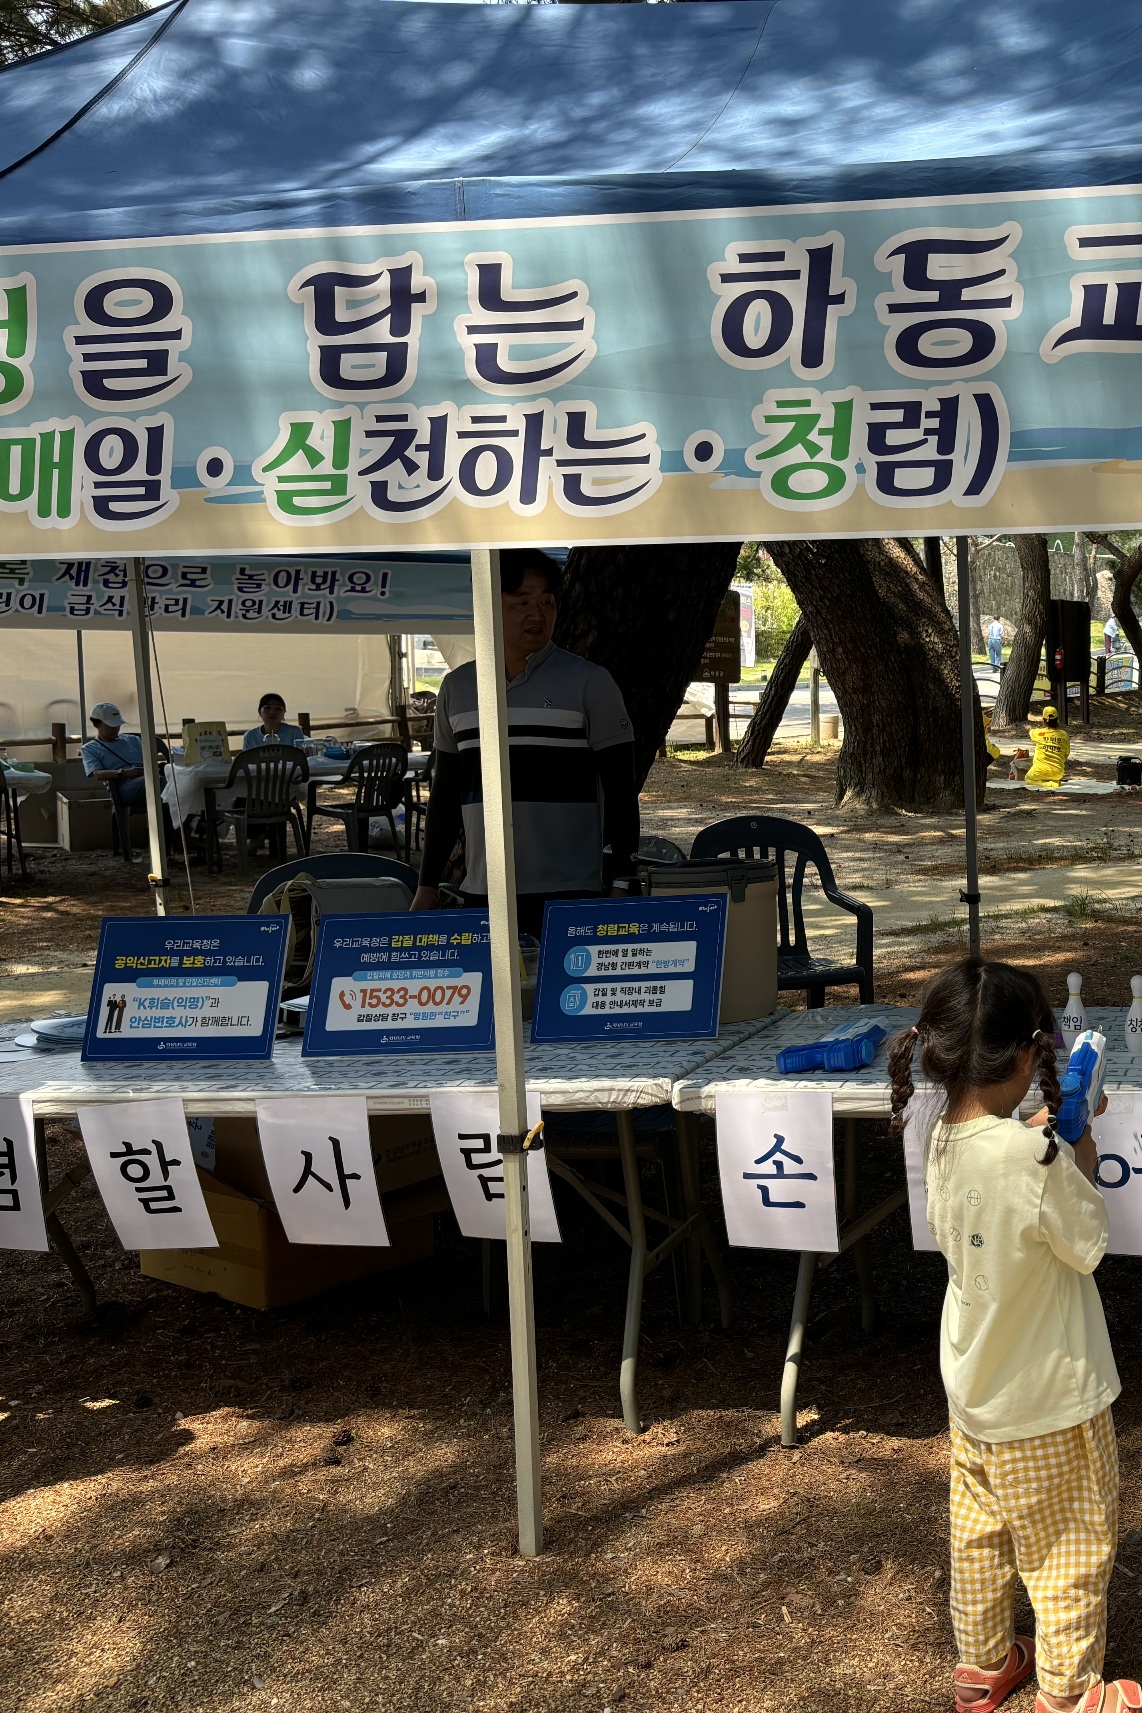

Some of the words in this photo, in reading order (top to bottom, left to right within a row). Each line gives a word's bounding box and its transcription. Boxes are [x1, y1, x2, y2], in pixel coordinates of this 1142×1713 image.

[298, 261, 586, 391] 담는
[55, 561, 211, 589] 재첩으로
[235, 567, 389, 597] 놀아봐요!
[208, 597, 336, 622] 지원센터)
[567, 925, 594, 937] 올해도
[596, 922, 648, 936] 청렴교육은
[650, 921, 698, 932] 계속됩니다.
[164, 939, 220, 950] 우리교육청은
[333, 936, 389, 949] 우리교육청은
[391, 935, 414, 948] 갑질
[416, 934, 447, 947] 대책을
[450, 933, 490, 945] 수립하고
[360, 951, 389, 963] 예방에
[391, 951, 418, 962] 힘쓰고
[421, 949, 459, 961] 있습니다.
[597, 948, 619, 959] 한번에
[631, 947, 653, 957] 일하는
[114, 956, 180, 969] 공익신고자를
[182, 956, 223, 968] 보호하고
[225, 955, 265, 966] 있습니다.
[596, 961, 618, 971] 경남형
[620, 960, 650, 971] 간편계약
[360, 984, 472, 1008] 1533-0079
[593, 987, 608, 997] 갑질
[610, 987, 617, 997] 및
[620, 986, 642, 996] 직장내
[643, 985, 666, 995] 괴롭힘
[592, 1000, 607, 1010] 대응
[609, 999, 646, 1010] 안내서제작
[648, 998, 662, 1008] 보급
[129, 1015, 199, 1028] 안심변호사가
[201, 1015, 251, 1028] 함께합니다.
[356, 1013, 389, 1023] 갑질상담
[391, 1012, 407, 1022] 창구
[1061, 1015, 1083, 1030] 책임
[109, 1139, 183, 1216] 할
[292, 1136, 362, 1211] 사
[741, 1132, 818, 1209] 손
